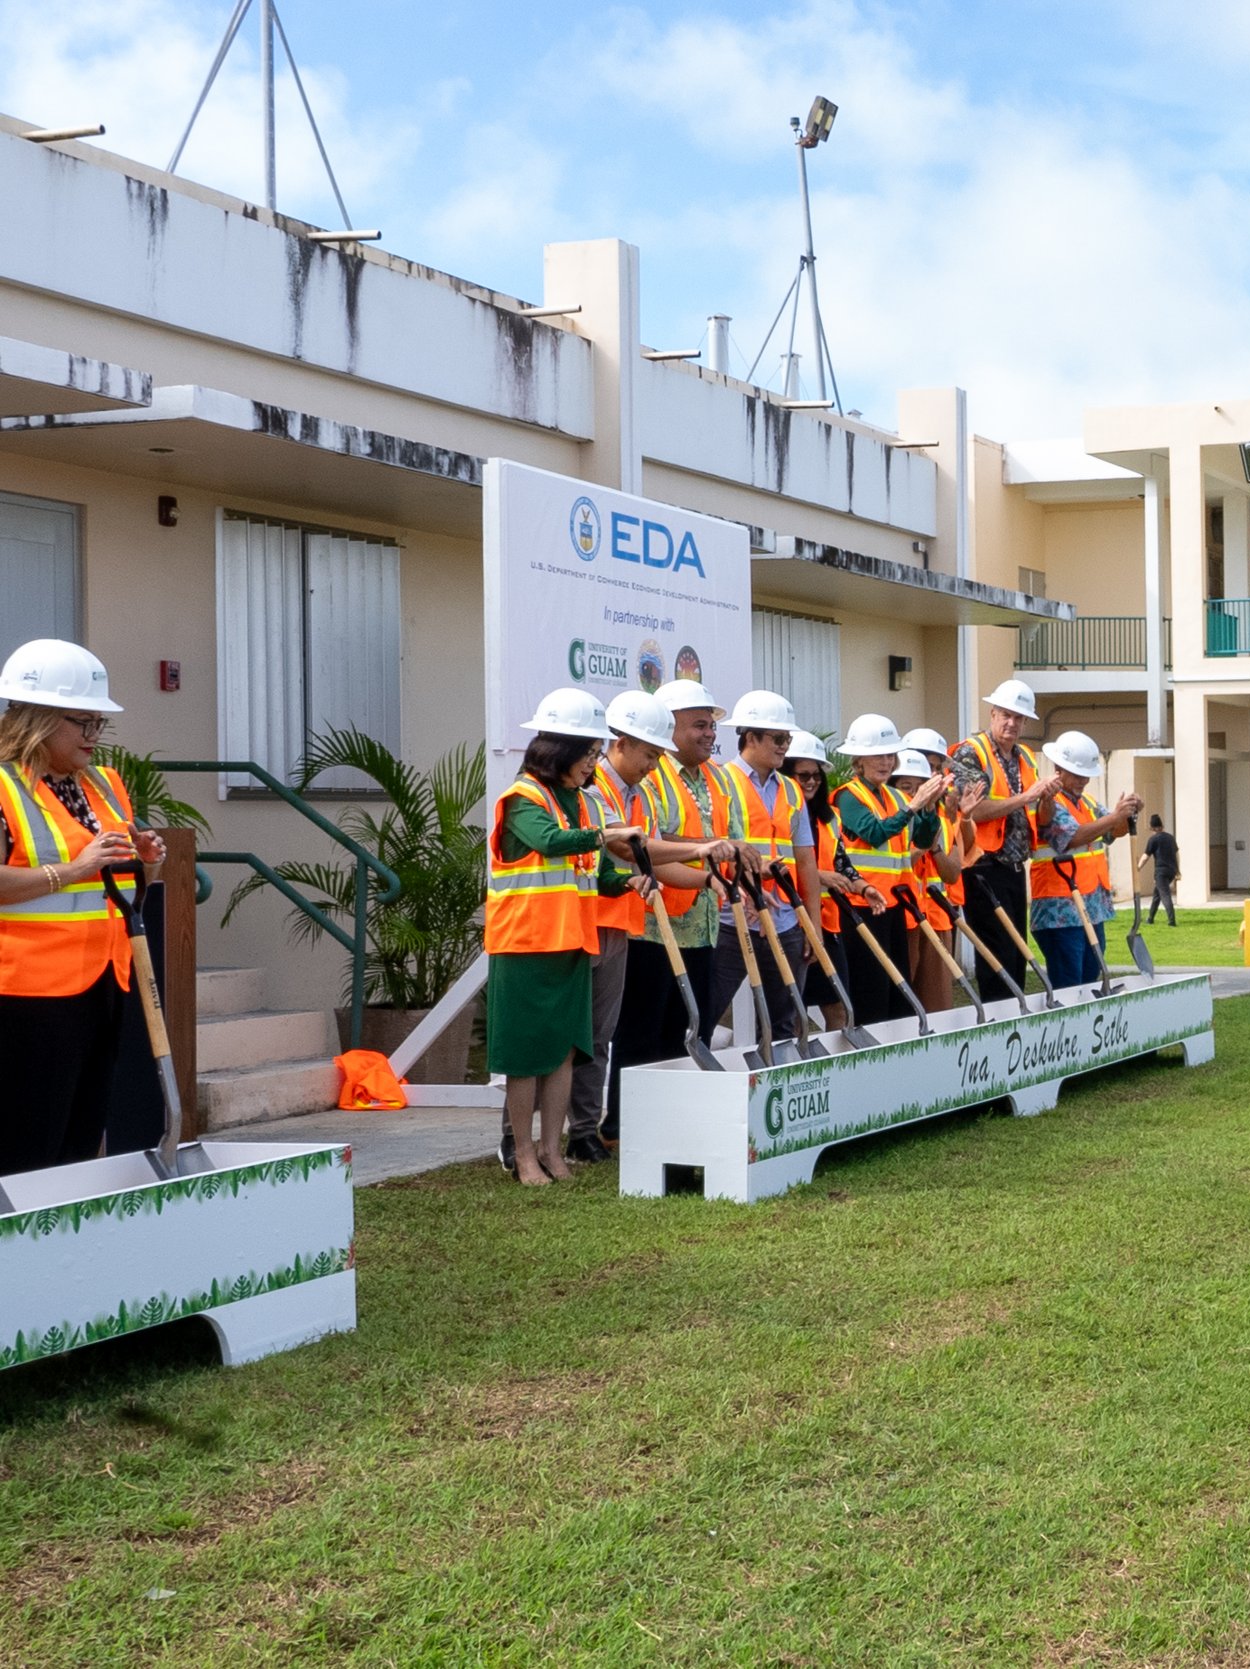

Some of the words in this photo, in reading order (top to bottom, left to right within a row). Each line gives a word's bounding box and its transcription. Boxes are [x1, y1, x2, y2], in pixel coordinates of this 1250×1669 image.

[611, 511, 706, 578] EDA
[530, 561, 546, 571] U.S.
[547, 564, 587, 579] DEPARTMENT
[604, 605, 611, 620] In
[613, 610, 658, 632] partnership
[660, 617, 675, 632] with
[588, 642, 619, 655] UNIVERSITY
[620, 647, 627, 656] OF
[588, 654, 627, 678] GUAM
[1091, 1006, 1129, 1054] Setbe
[787, 1079, 822, 1095] UNIVERSITY
[823, 1076, 830, 1087] OF
[787, 1090, 830, 1122] GUAM
